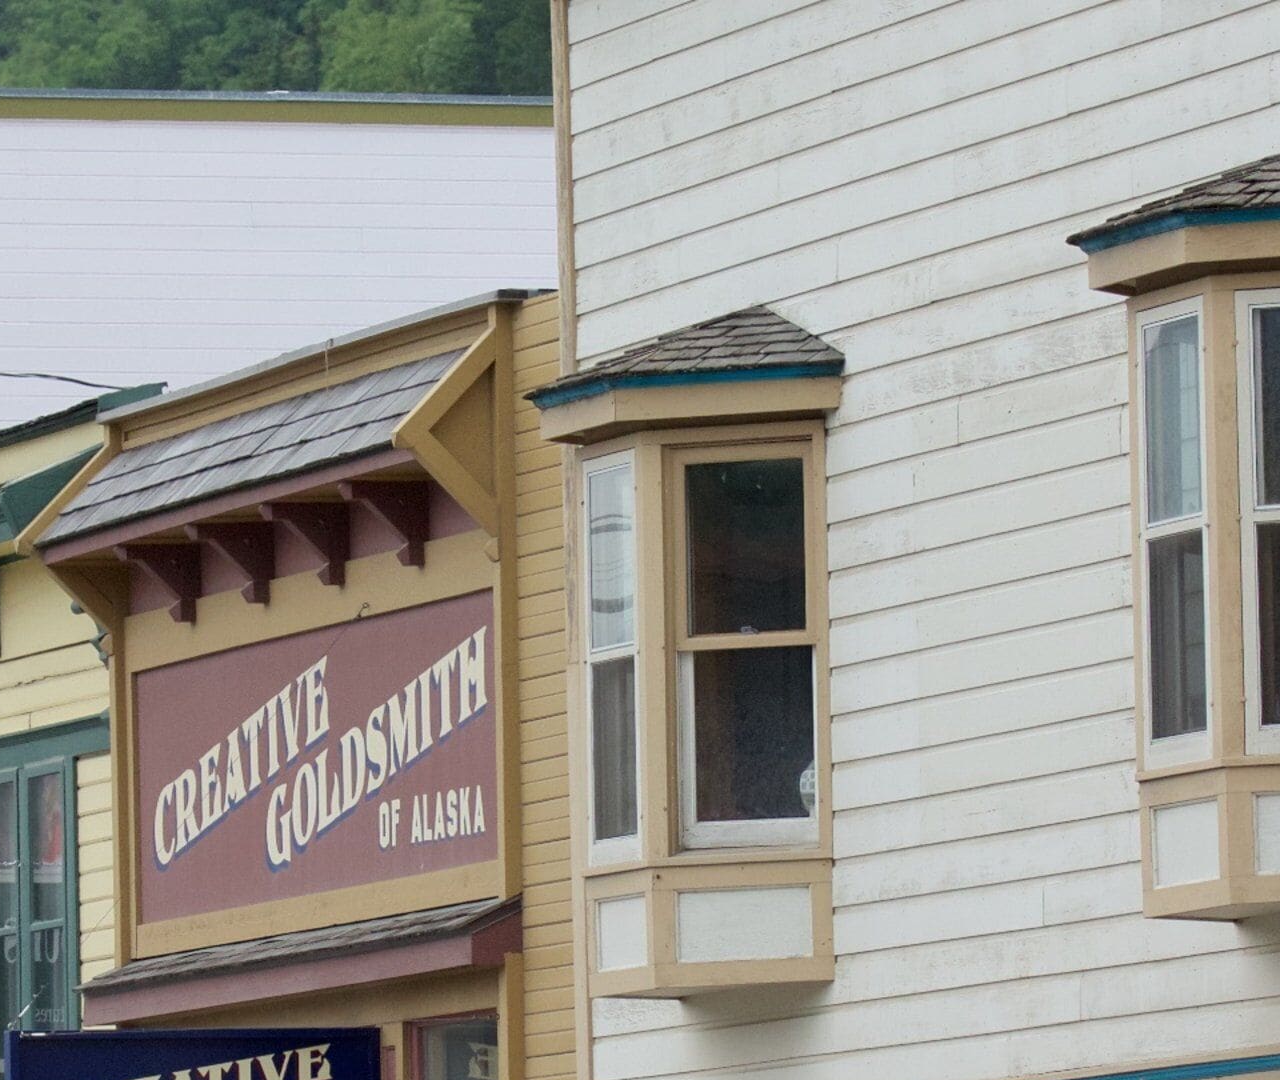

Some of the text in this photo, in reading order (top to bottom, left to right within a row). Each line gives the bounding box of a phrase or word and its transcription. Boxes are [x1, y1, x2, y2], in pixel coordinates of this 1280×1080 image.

[154, 654, 330, 867] CREATIVE
[266, 625, 488, 867] GOLDSMITH
[378, 785, 485, 848] OF ALASKA
